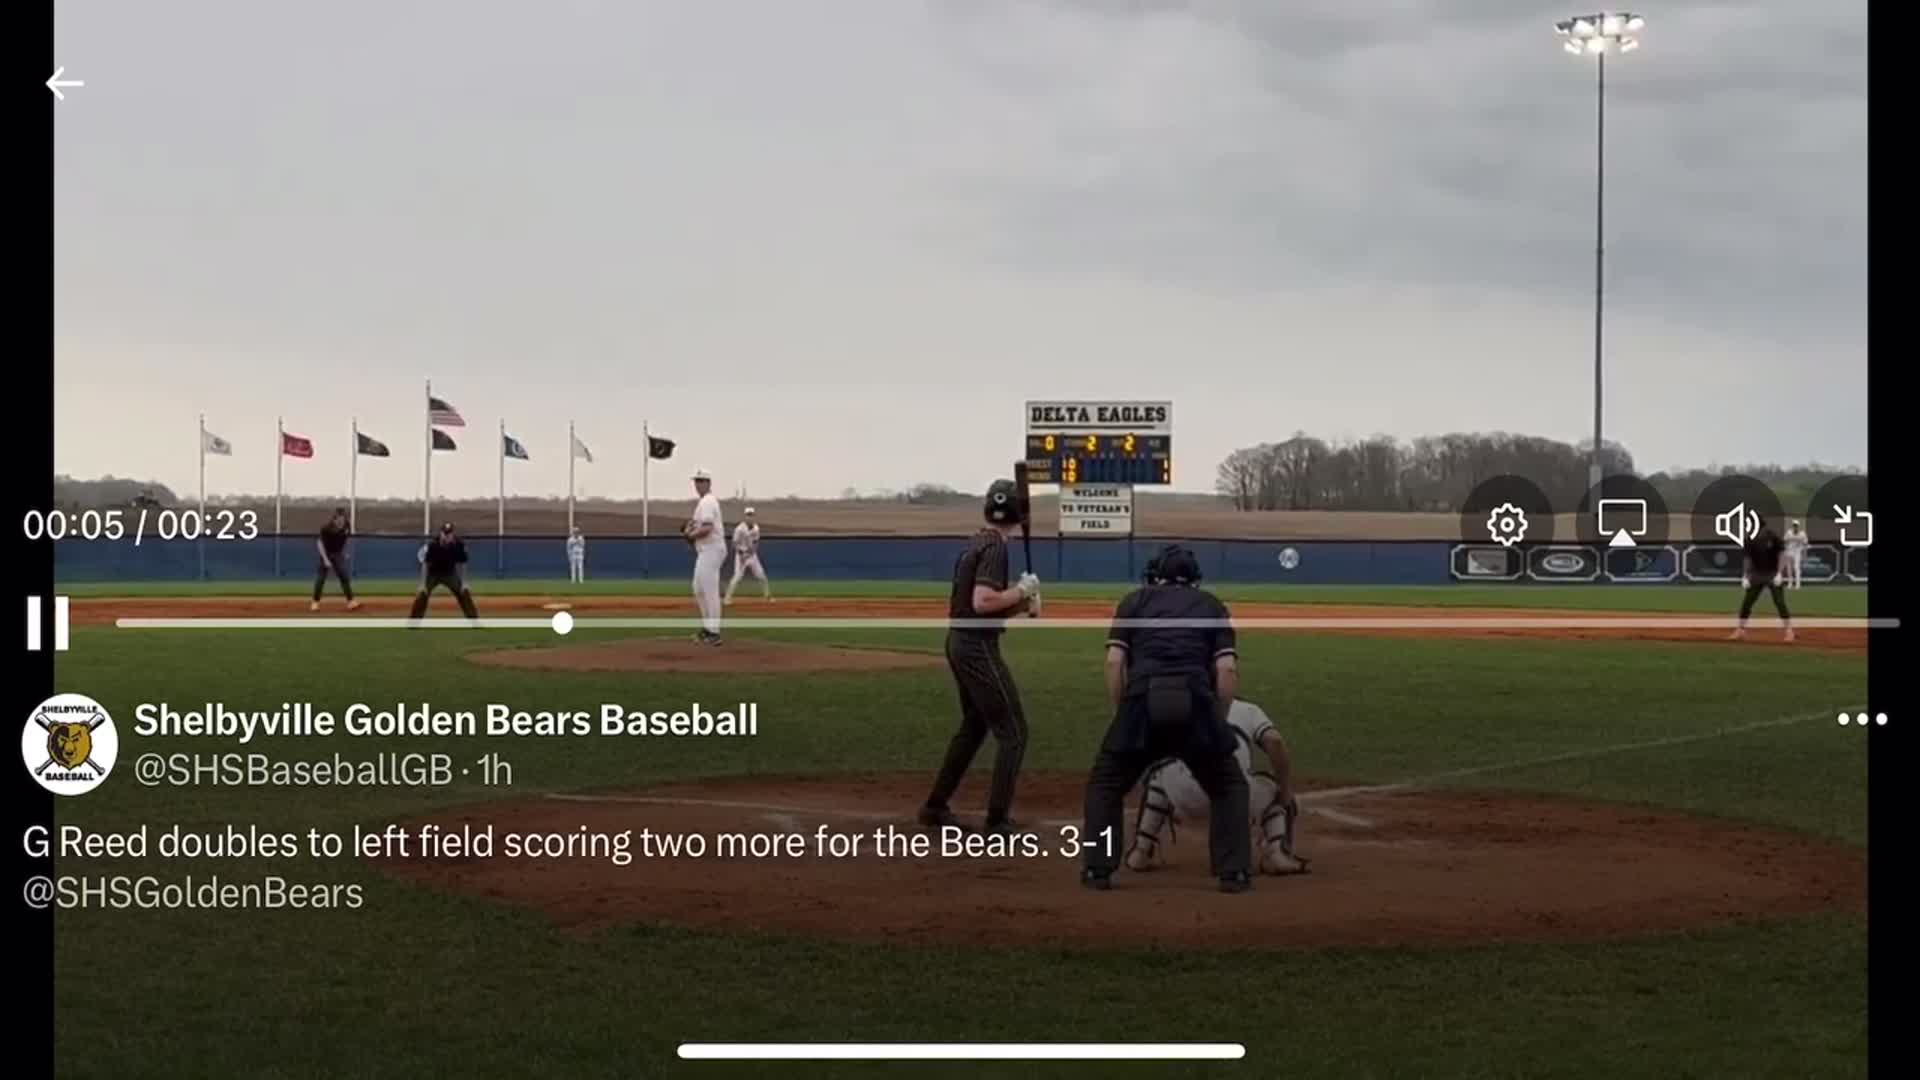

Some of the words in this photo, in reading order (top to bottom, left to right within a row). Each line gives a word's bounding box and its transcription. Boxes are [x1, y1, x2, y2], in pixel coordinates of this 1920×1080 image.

[1032, 406, 1090, 423] DELTA
[1097, 406, 1167, 423] EAGLES
[1087, 435, 1097, 451] 2
[1124, 435, 1135, 451] 2
[1073, 488, 1119, 497] WELCOME
[1062, 504, 1073, 513] TO
[1080, 520, 1110, 529] FIELD
